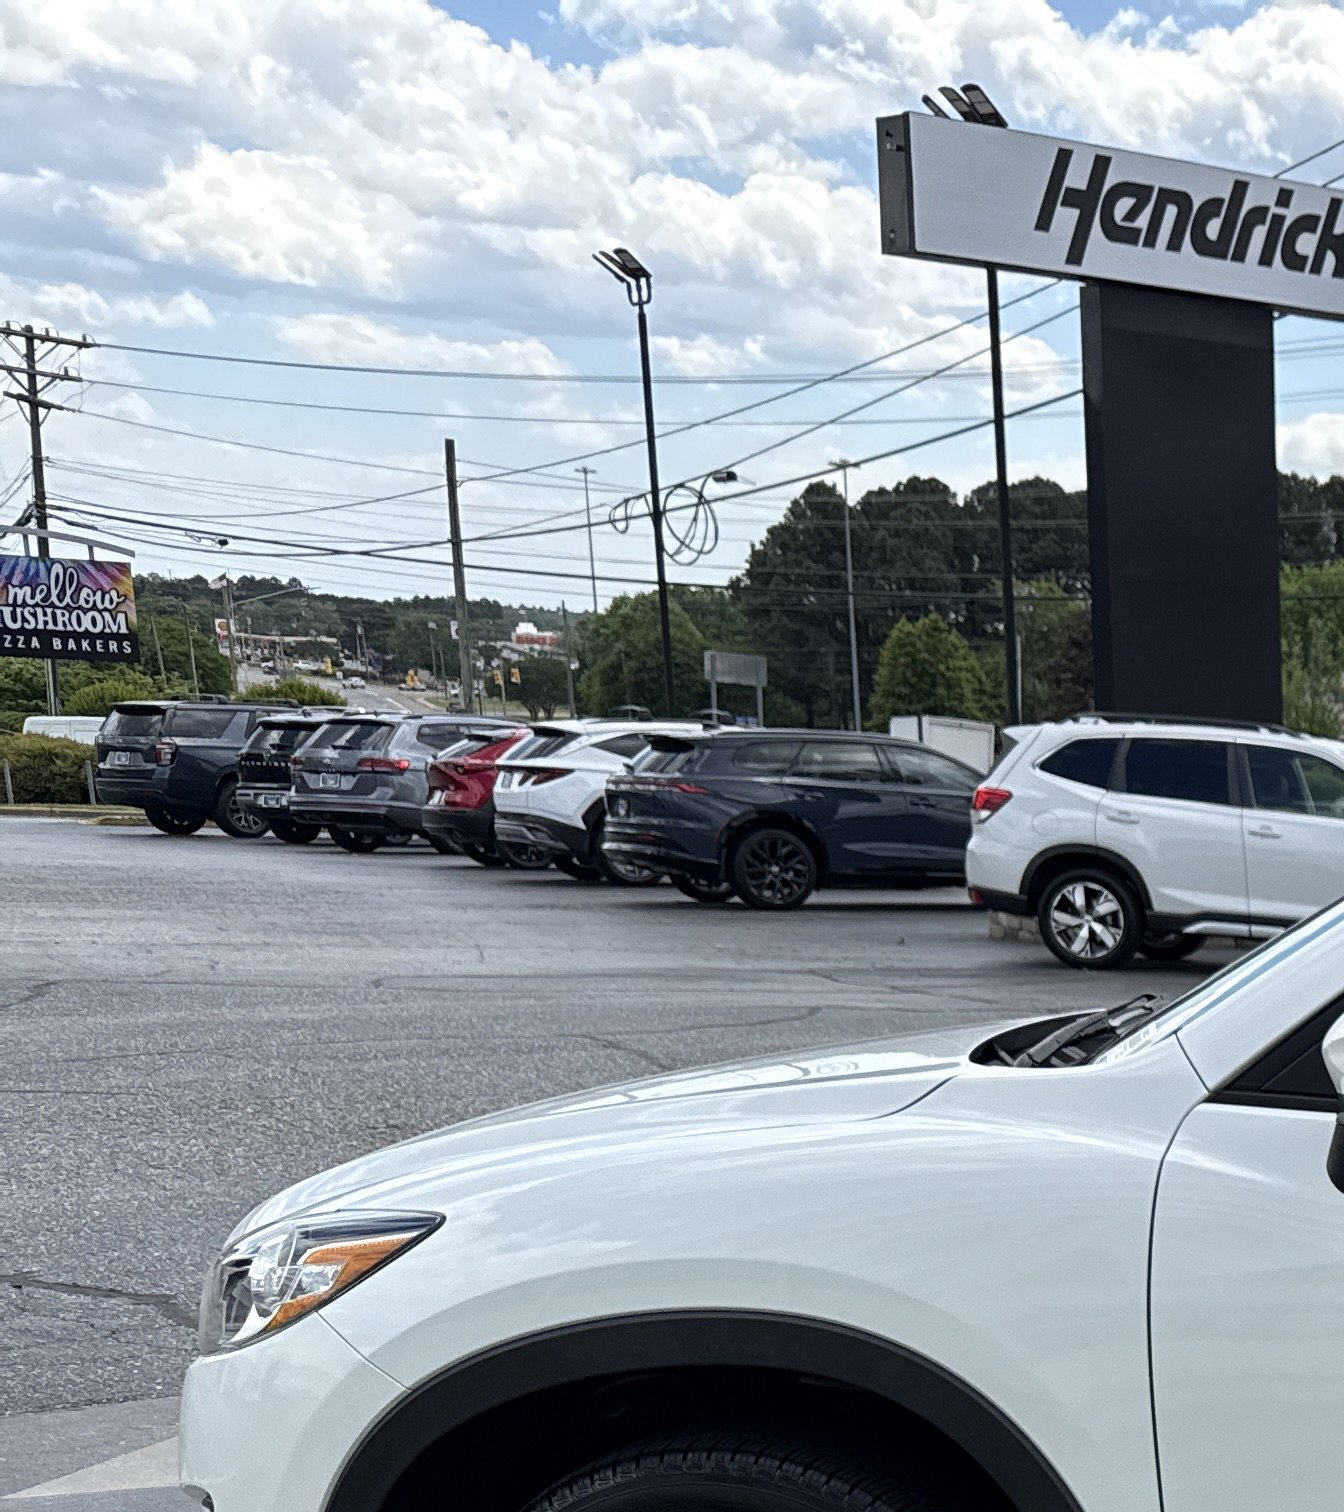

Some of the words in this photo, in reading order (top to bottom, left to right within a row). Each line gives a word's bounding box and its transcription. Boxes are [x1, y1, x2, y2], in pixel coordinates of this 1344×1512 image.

[7, 562, 127, 610] mellow
[0, 605, 130, 635] USHROOM
[3, 634, 41, 650] ZZA
[52, 637, 132, 654] BAKERS
